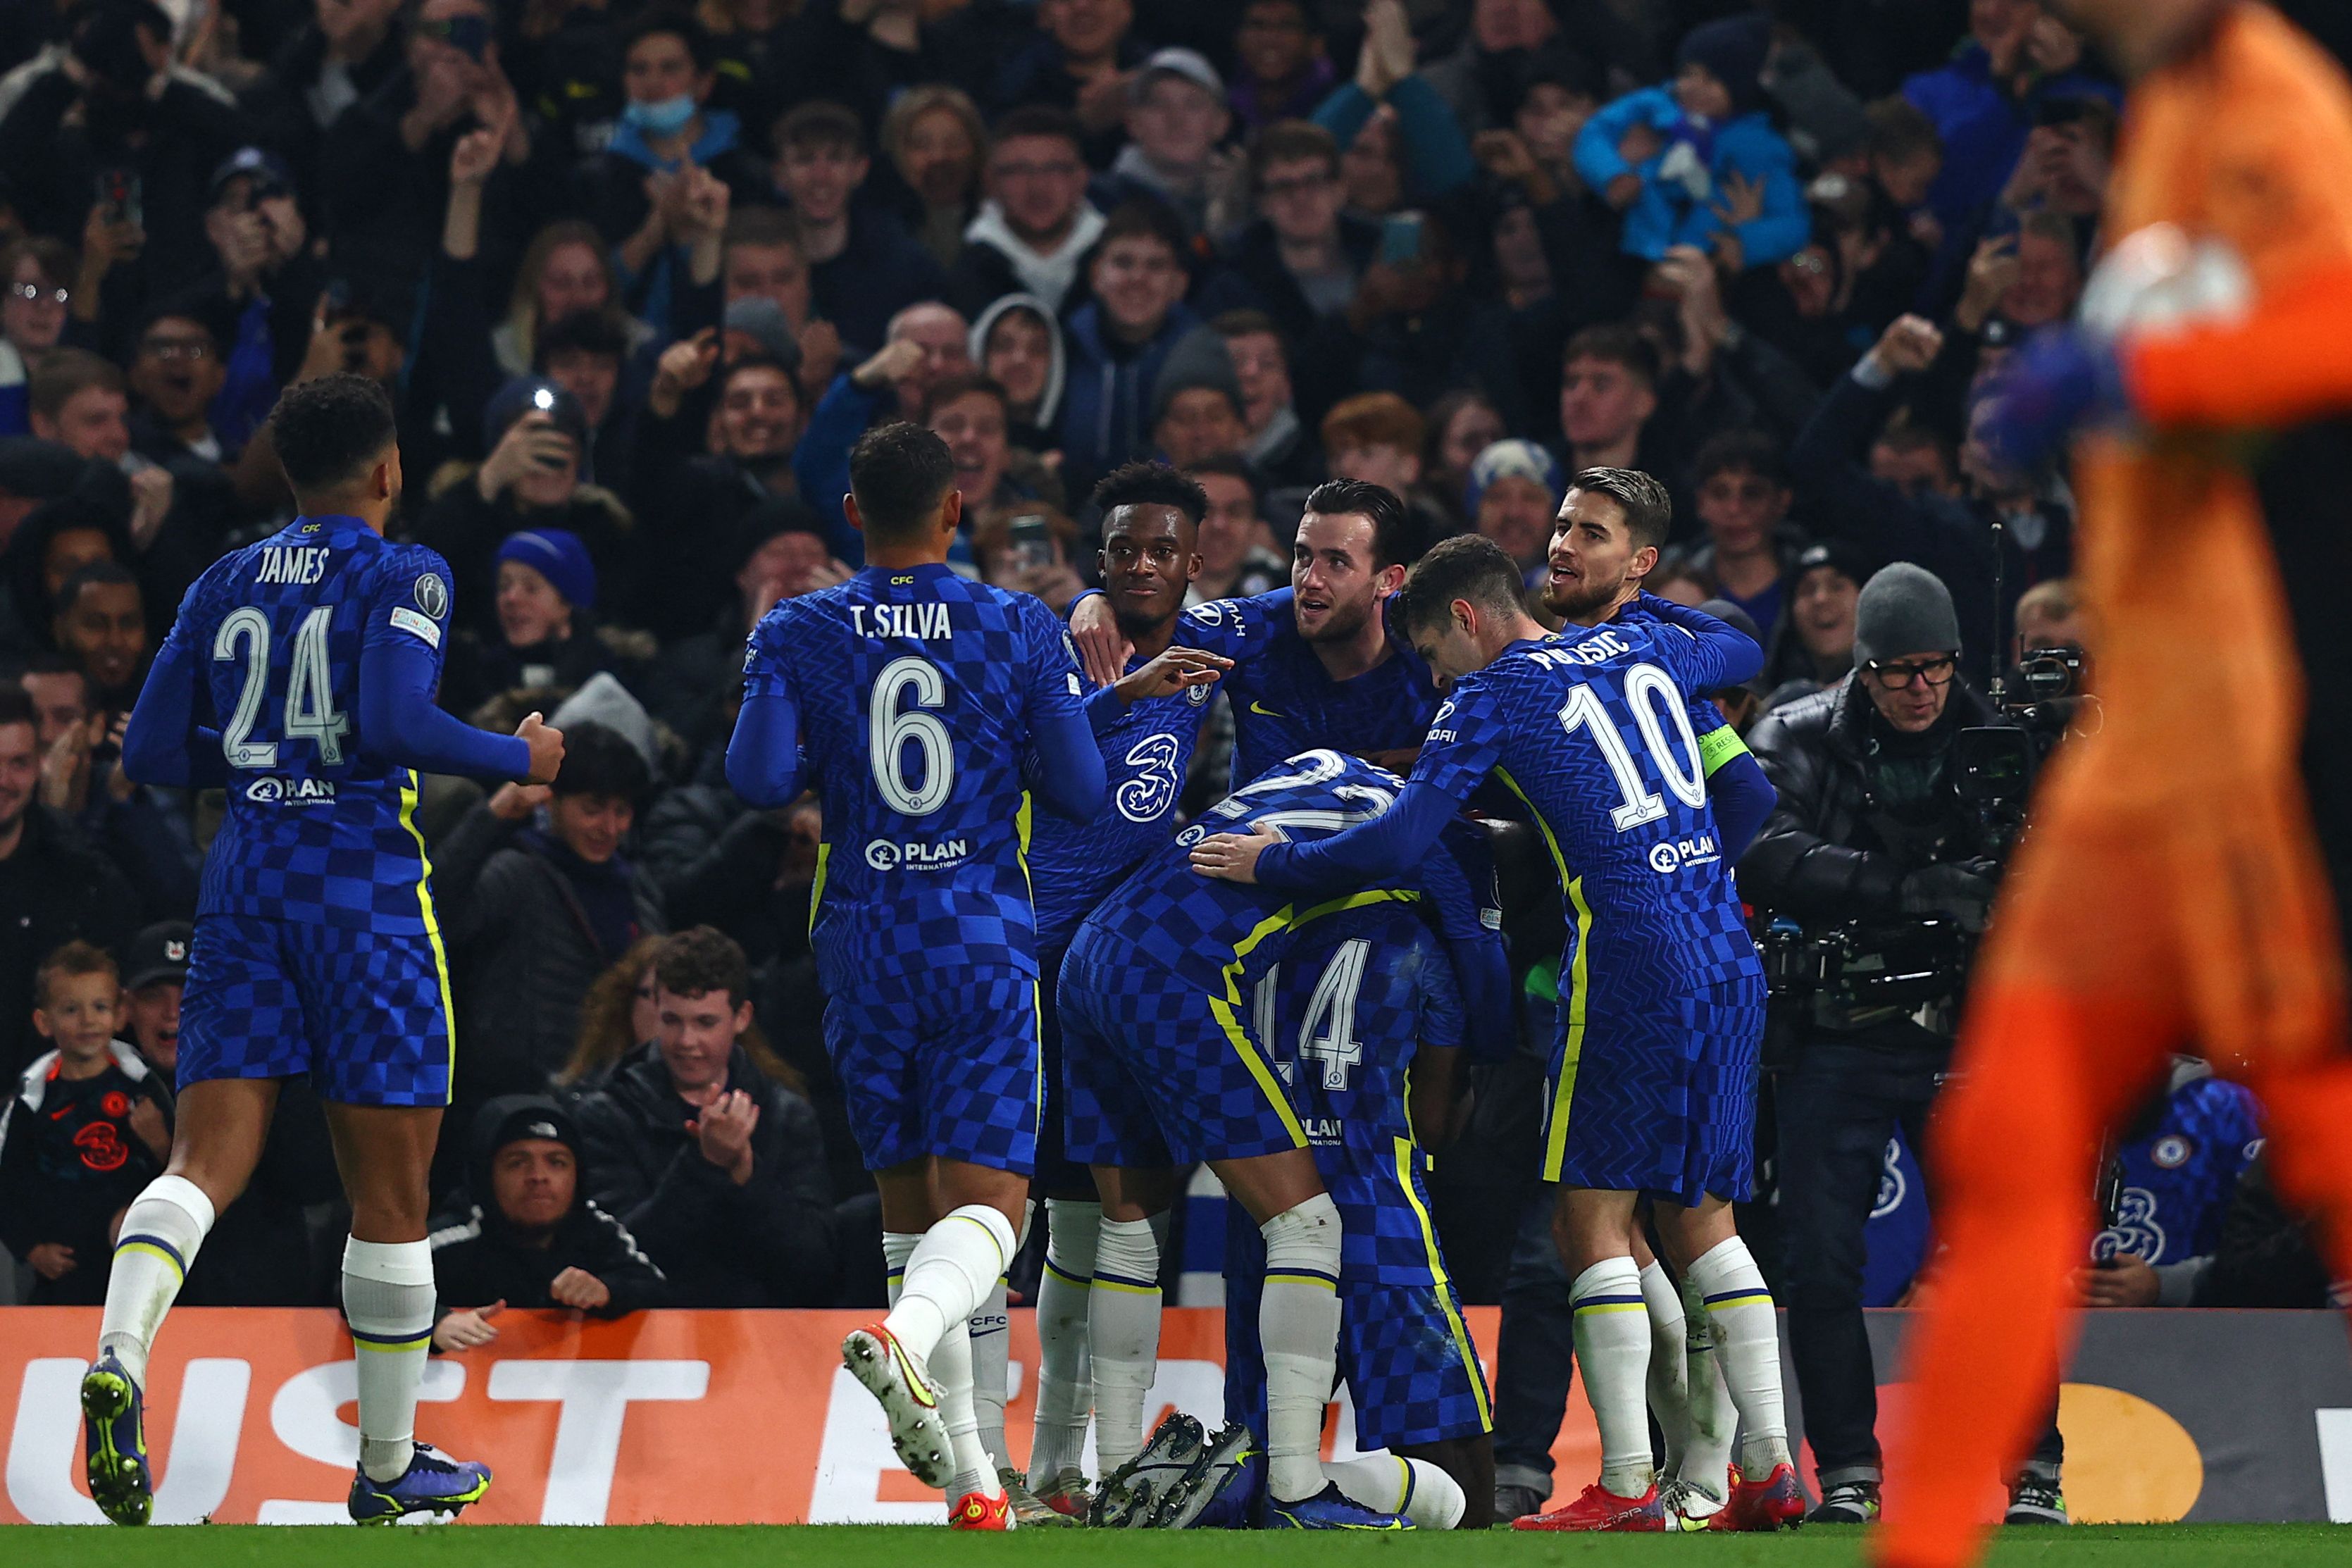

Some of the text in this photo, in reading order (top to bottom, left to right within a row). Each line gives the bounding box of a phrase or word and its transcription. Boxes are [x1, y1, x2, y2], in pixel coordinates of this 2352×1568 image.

[301, 524, 321, 533] CFC
[255, 547, 330, 584] JAMES
[890, 576, 914, 585] CFC
[850, 603, 952, 640] T.SILVA
[213, 606, 351, 768] 24
[869, 656, 954, 816] 6
[1557, 663, 1706, 833] 10
[286, 778, 335, 797] PLAN
[1116, 733, 1178, 822] 3
[1207, 748, 1396, 844] 22
[905, 839, 966, 861] PLAN
[906, 858, 965, 871] INTERNATION
[1678, 835, 1715, 859] PLAN
[1253, 938, 1371, 1091] 14
[970, 1316, 1007, 1326] CFC
